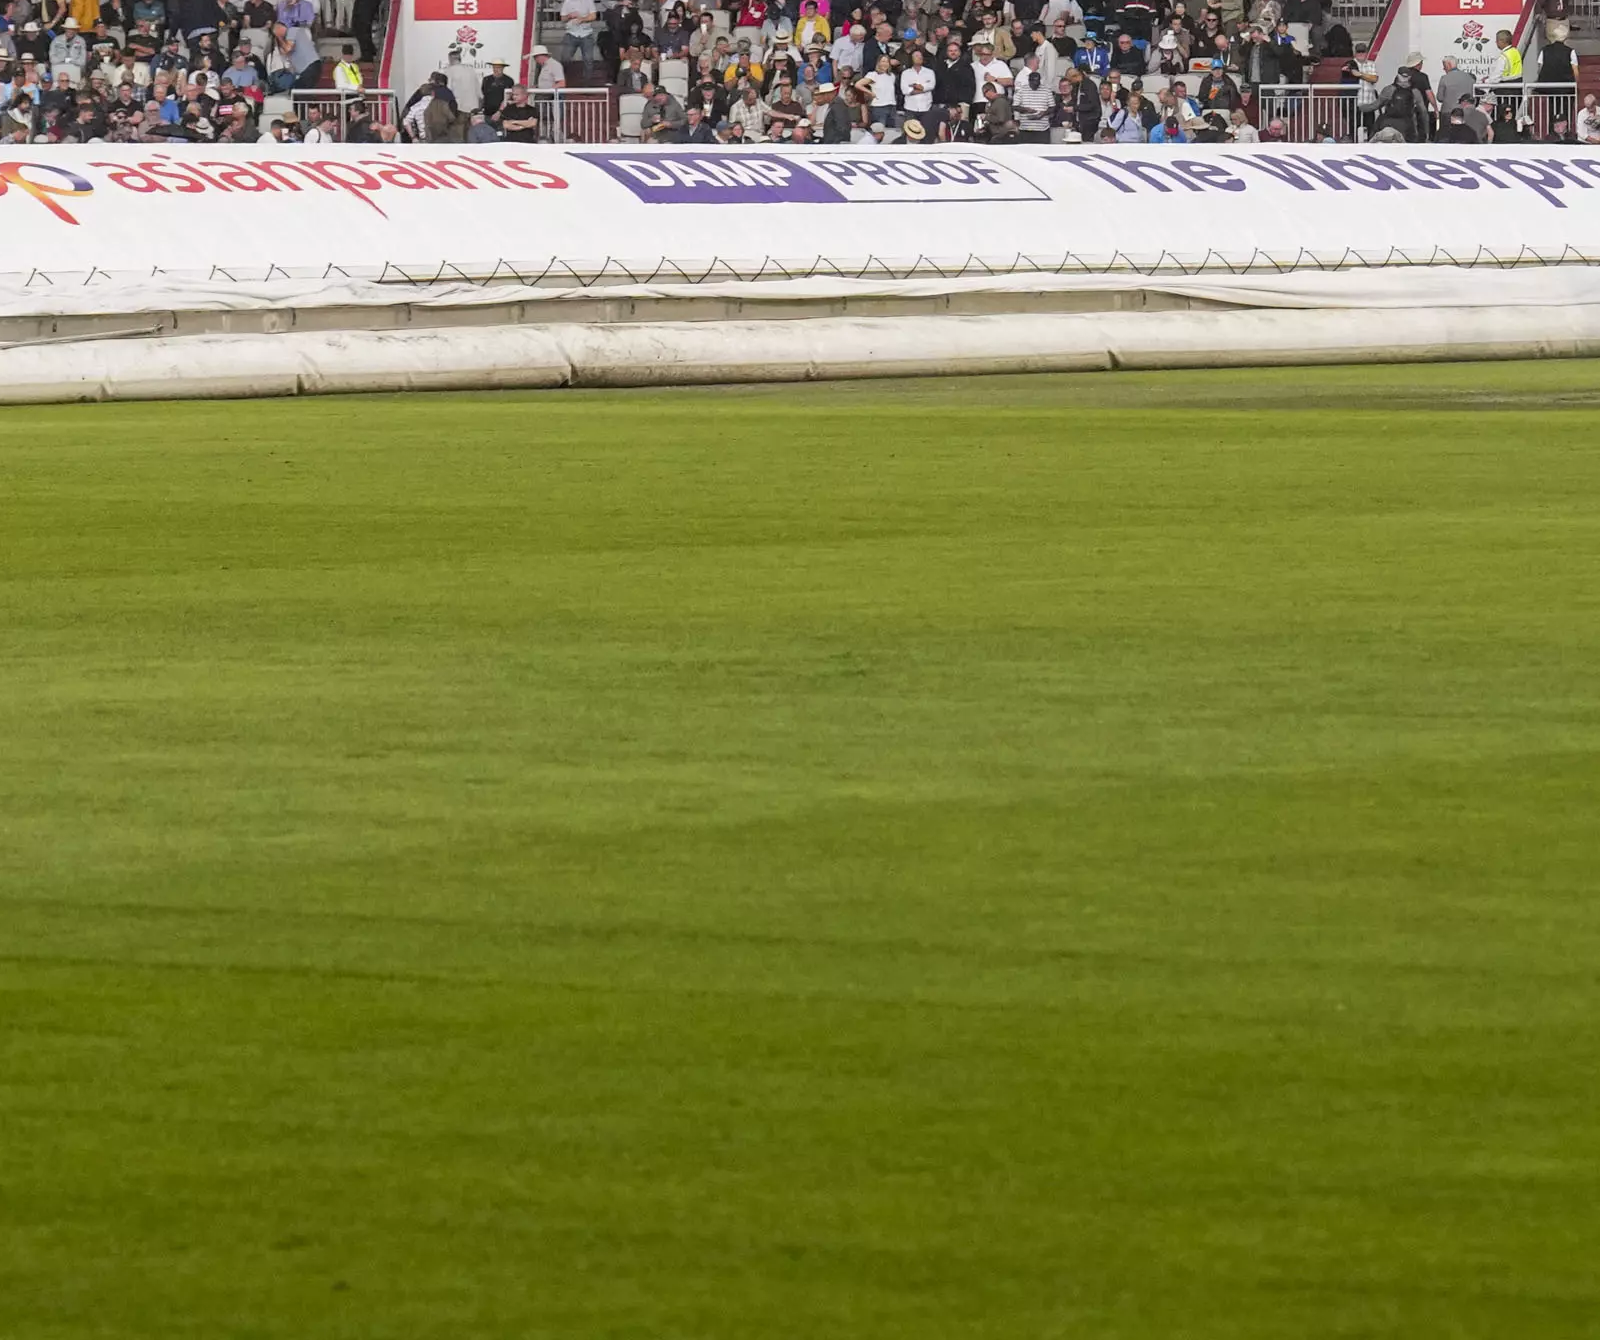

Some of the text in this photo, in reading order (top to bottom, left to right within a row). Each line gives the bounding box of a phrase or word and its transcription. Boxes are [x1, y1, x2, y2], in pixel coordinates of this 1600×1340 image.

[86, 153, 569, 221] asianpaints
[614, 159, 1002, 188] DAMP PROOF
[1038, 154, 1247, 193] The
